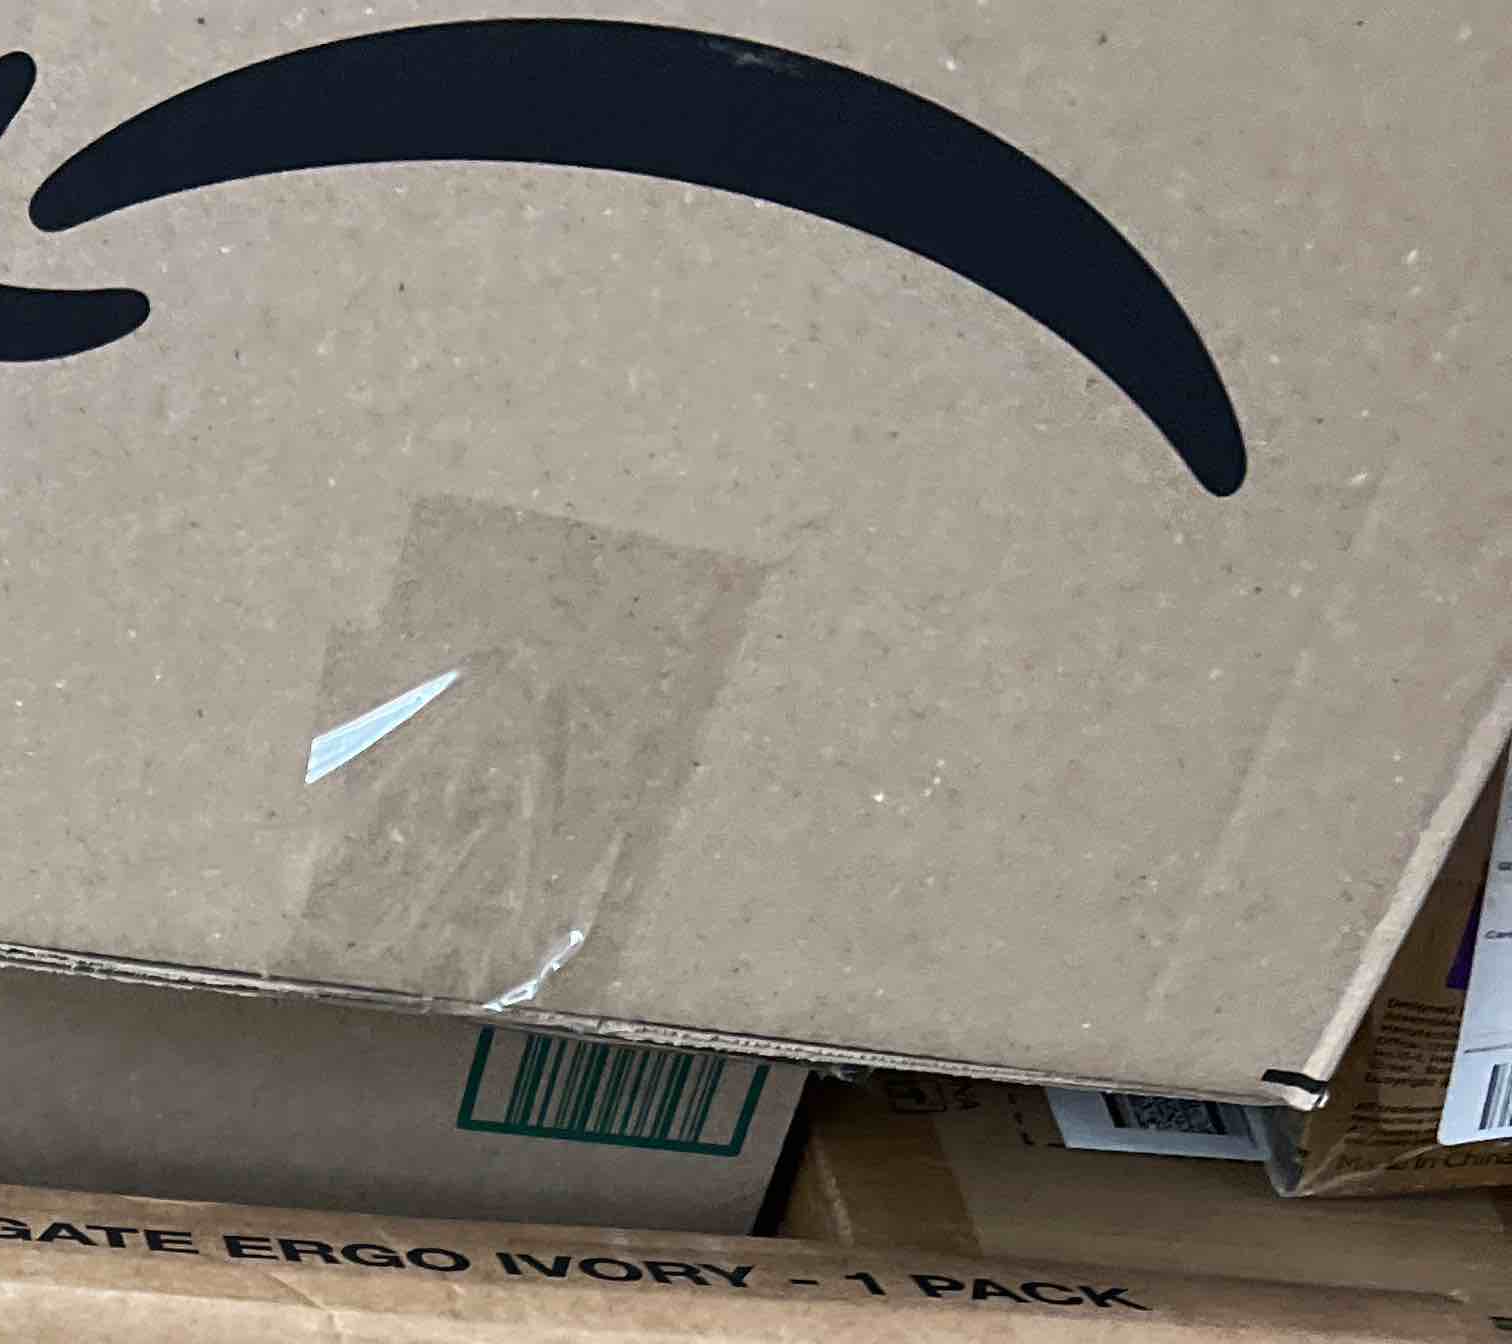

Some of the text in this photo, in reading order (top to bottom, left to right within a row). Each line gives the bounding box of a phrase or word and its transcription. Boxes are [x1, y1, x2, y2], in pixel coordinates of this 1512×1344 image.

[222, 1235, 472, 1272] ERGO
[495, 1252, 755, 1289] IVORY
[843, 1272, 887, 1296] 1
[907, 1273, 1153, 1311] PACK
